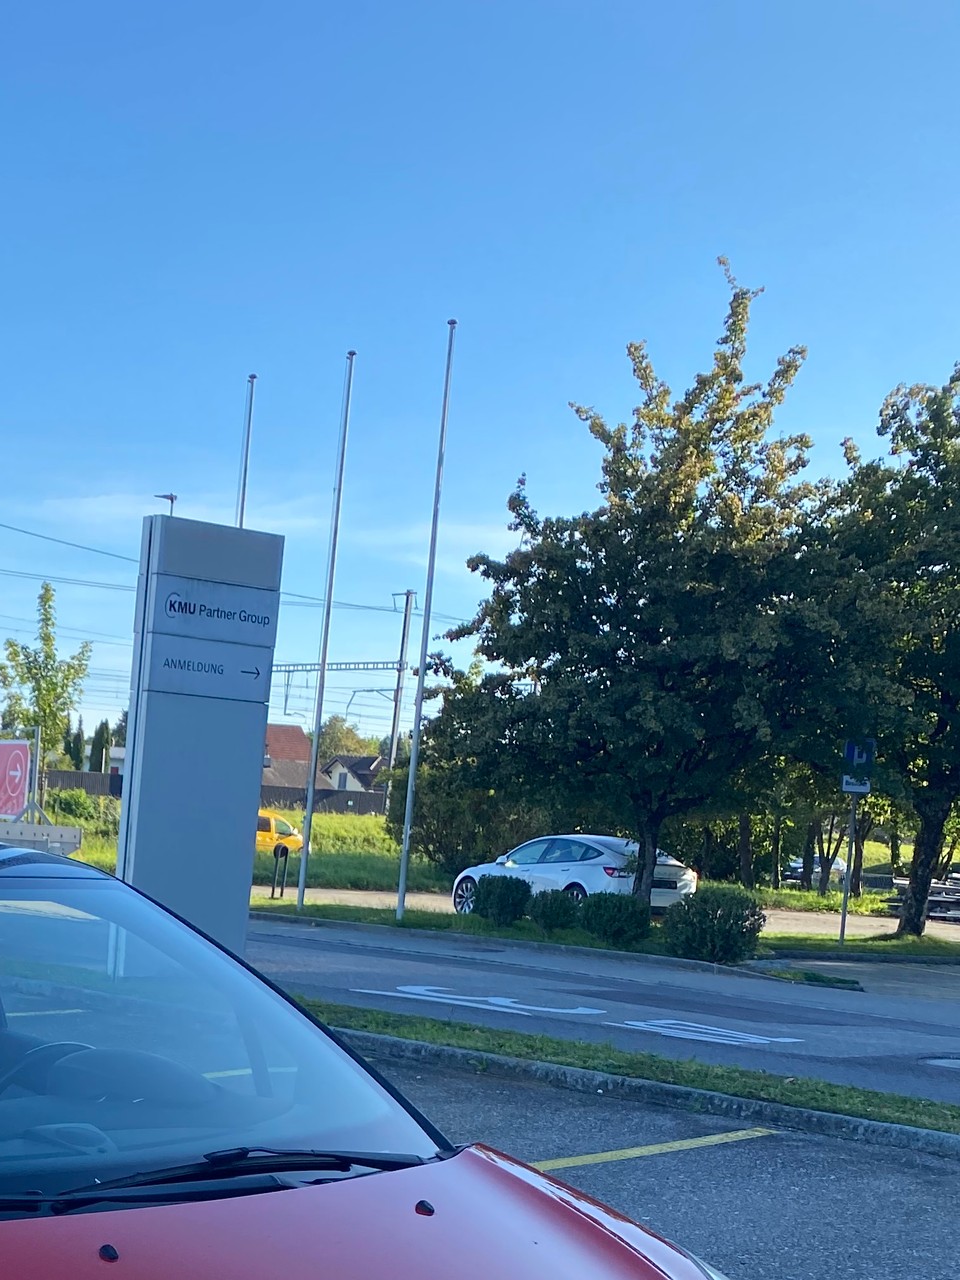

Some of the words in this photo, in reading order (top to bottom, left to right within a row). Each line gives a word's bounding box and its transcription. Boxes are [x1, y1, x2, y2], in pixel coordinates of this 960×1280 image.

[168, 599, 197, 615] KMU
[199, 604, 237, 621] Partner
[239, 609, 270, 628] Group
[163, 657, 224, 675] ANMELDUNG
